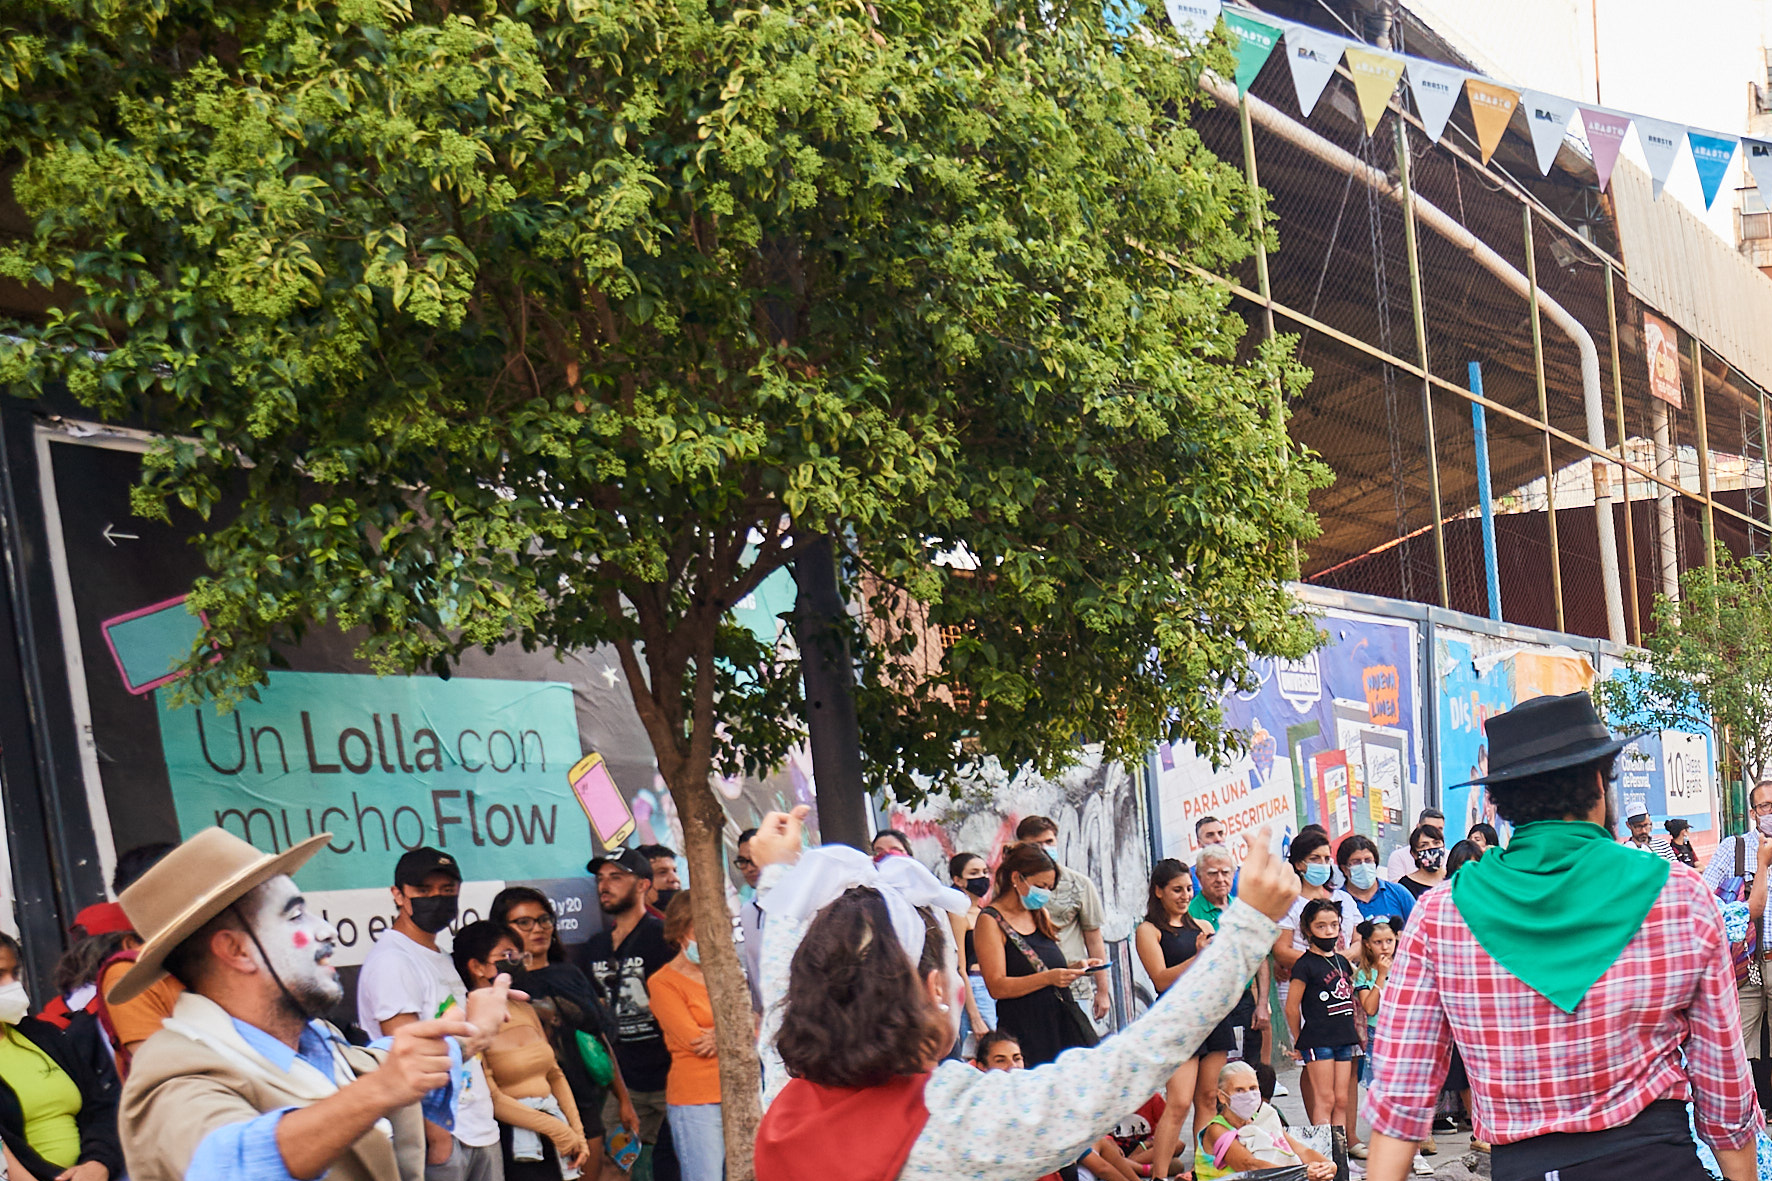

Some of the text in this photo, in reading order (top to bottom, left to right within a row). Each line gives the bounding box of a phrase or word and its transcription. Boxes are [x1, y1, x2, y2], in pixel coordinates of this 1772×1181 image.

[195, 707, 547, 776] Un Lolla con
[1183, 778, 1249, 820] PARA UNA
[1667, 752, 1685, 797] 10
[214, 789, 558, 855] mucho Flow
